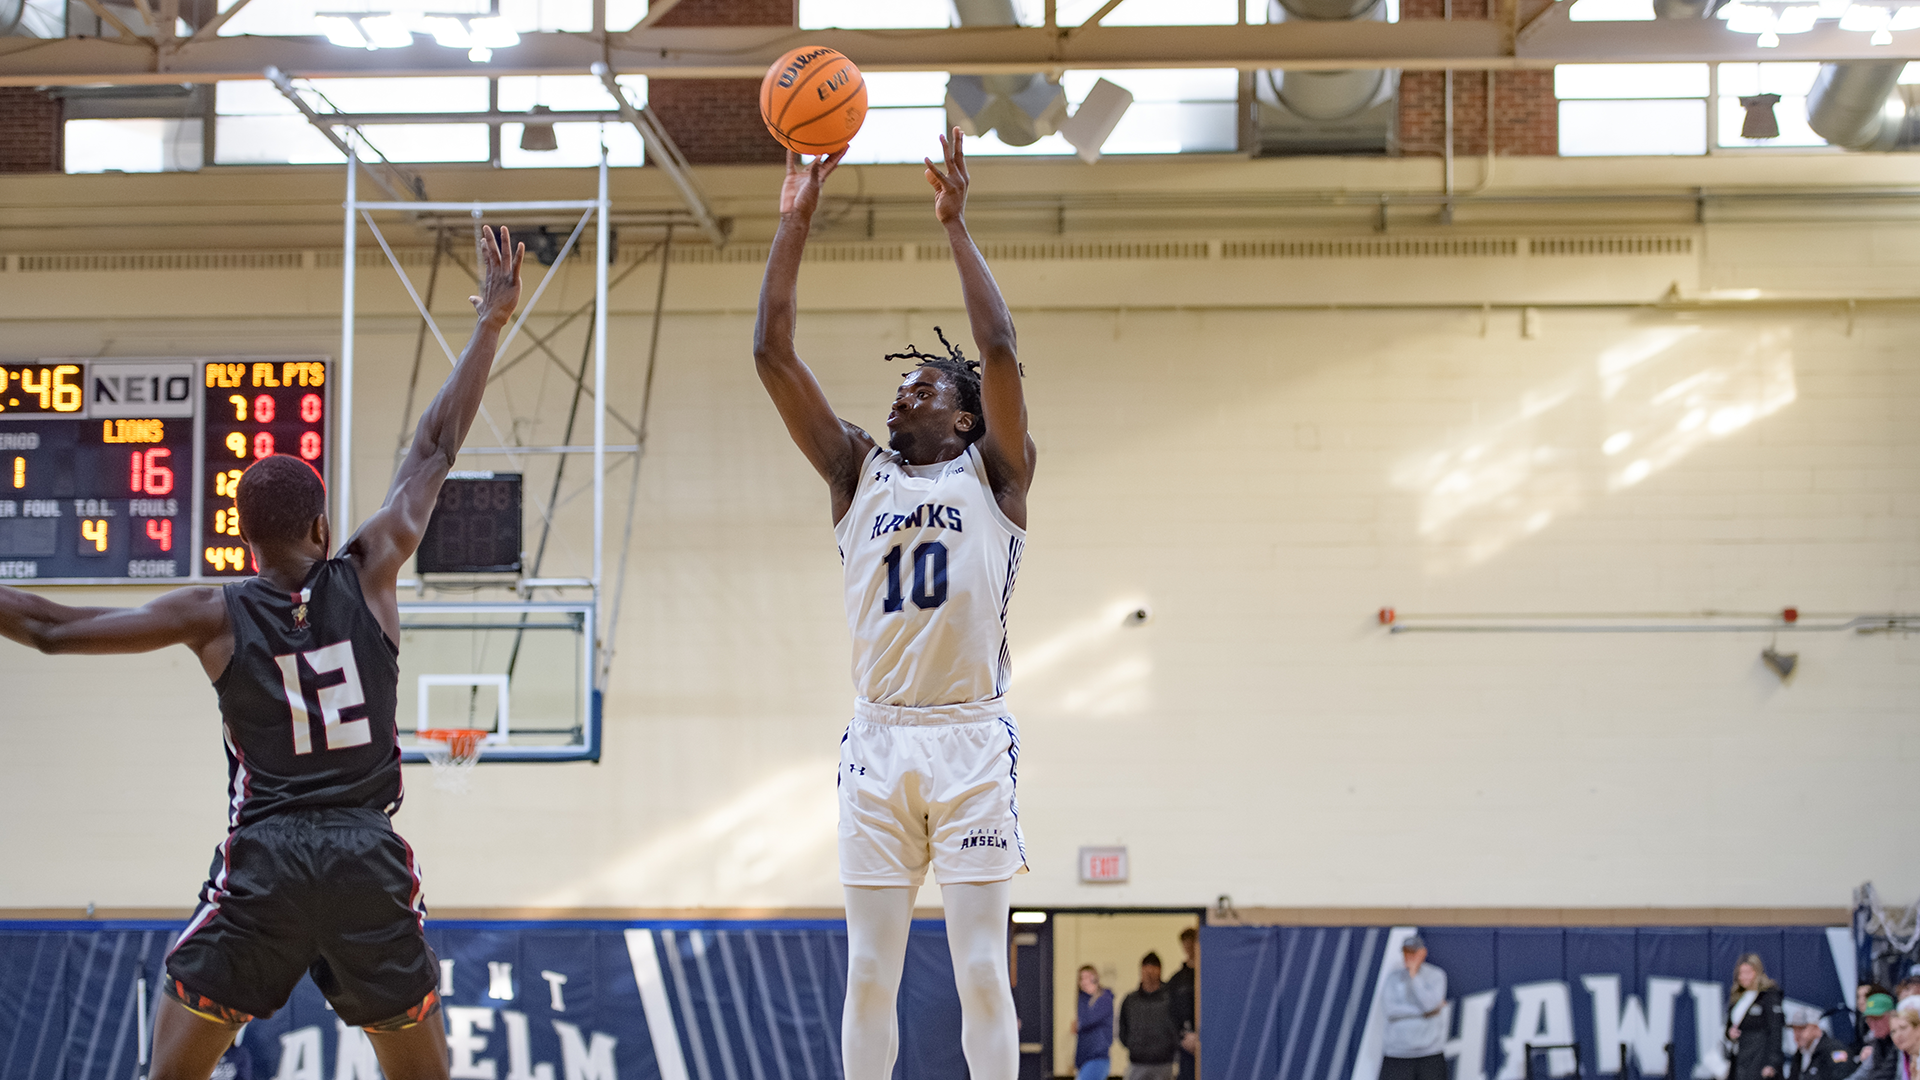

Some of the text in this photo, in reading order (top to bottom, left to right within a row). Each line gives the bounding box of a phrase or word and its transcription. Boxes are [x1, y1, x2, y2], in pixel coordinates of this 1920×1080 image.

[0, 365, 82, 412] :46
[253, 363, 280, 387] FL
[283, 362, 325, 387] PTS
[95, 377, 190, 403] NE10
[229, 394, 322, 423] 7 0 0
[103, 419, 164, 443] LIONS
[226, 432, 322, 460] 9 0 0
[14, 457, 26, 489] 1
[131, 448, 174, 495] 16
[23, 500, 62, 518] FOUL
[129, 499, 178, 517] FOULS
[870, 503, 963, 541] HAWKS
[82, 519, 108, 552] 4
[146, 518, 172, 551] 4
[128, 560, 177, 578] SCORE
[205, 547, 245, 571] 44
[882, 540, 950, 615] 10
[274, 640, 373, 756] 12
[960, 835, 1007, 850] ANSELM
[1090, 856, 1119, 878] EXIT
[270, 1005, 618, 1080] ANELM
